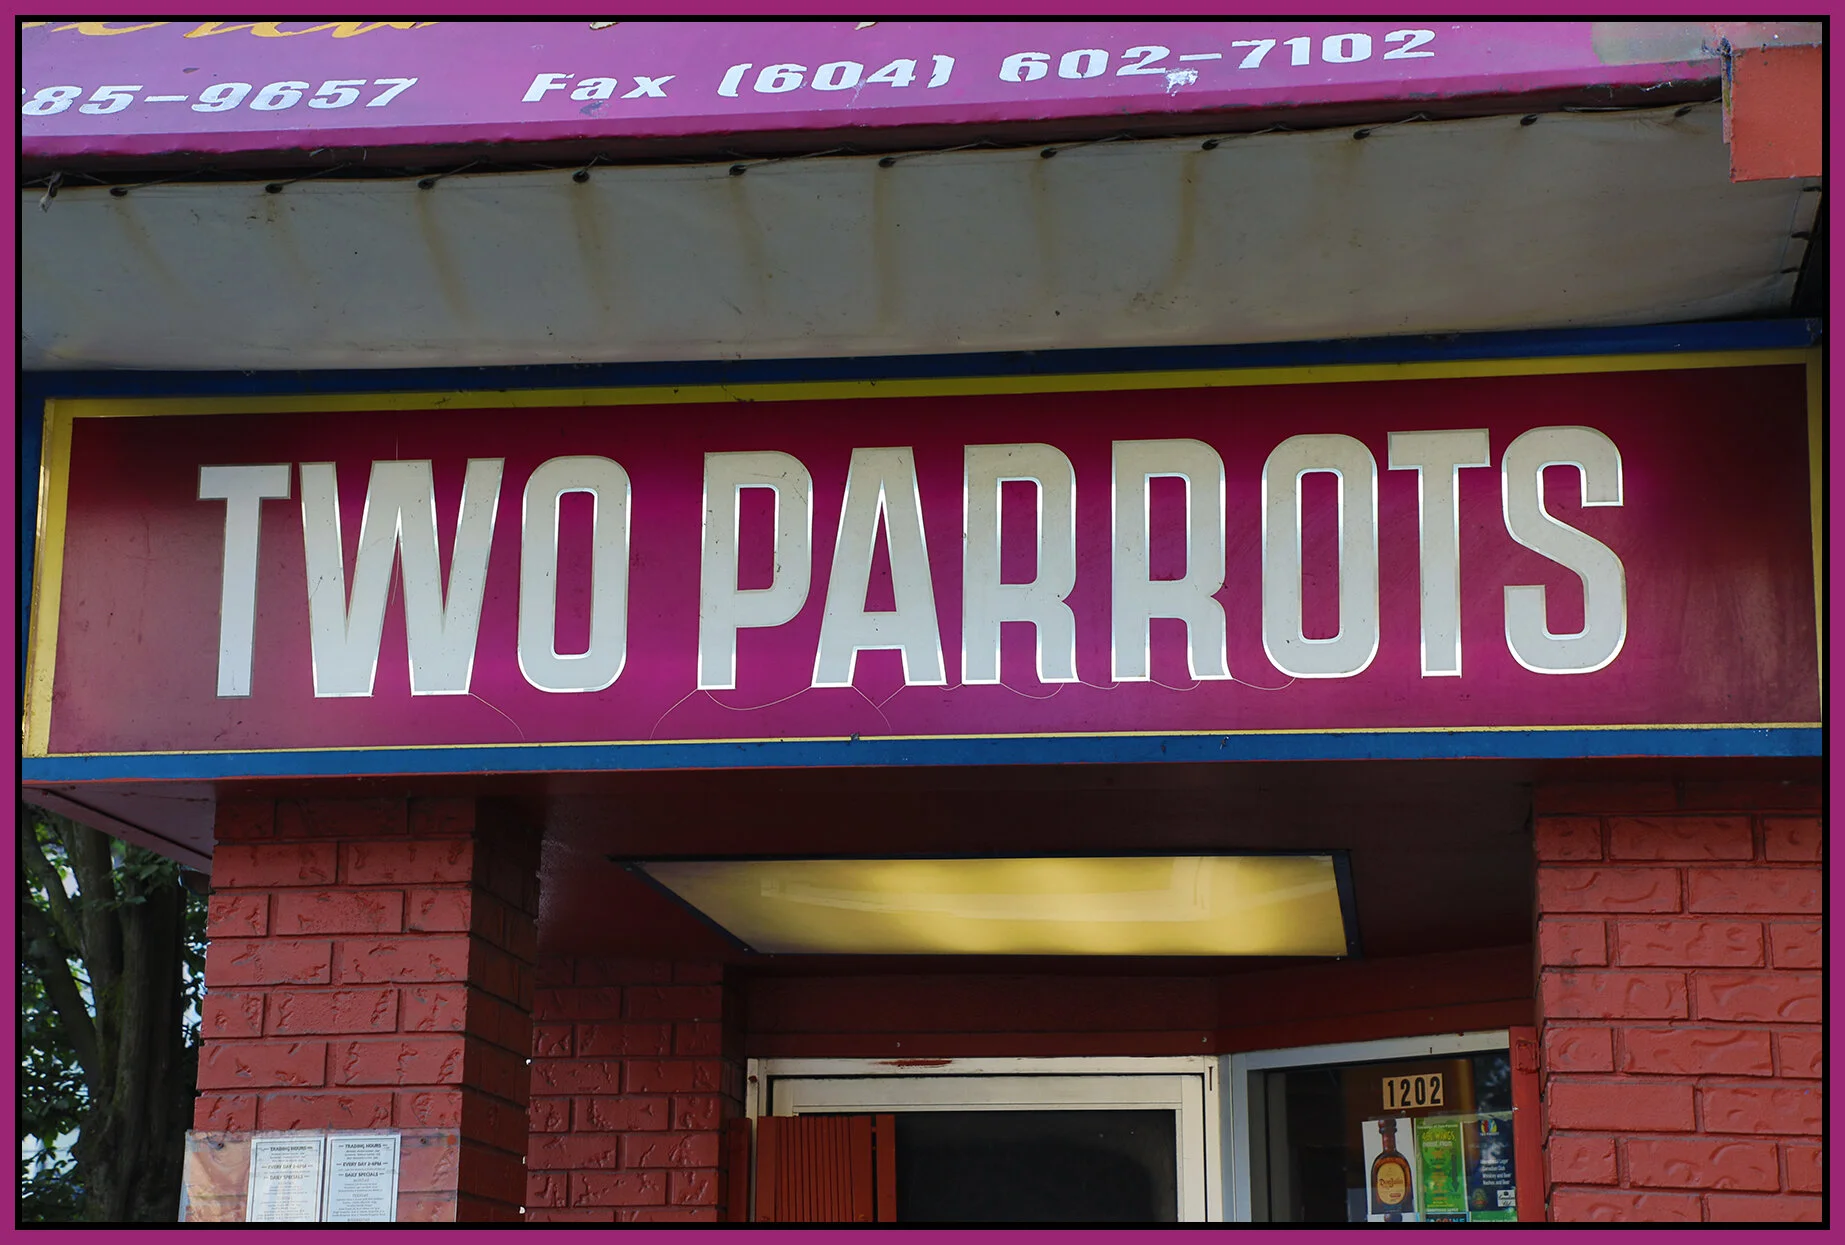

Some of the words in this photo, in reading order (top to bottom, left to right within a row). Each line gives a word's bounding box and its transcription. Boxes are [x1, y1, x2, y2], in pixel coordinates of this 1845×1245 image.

[22, 77, 418, 115] 85-9657
[522, 71, 677, 103] Fax
[716, 54, 955, 98] (604)
[999, 29, 1435, 82] 602-7102
[197, 455, 632, 698] TWO
[697, 426, 1628, 690] PARROTS
[1387, 1076, 1441, 1107] 1202
